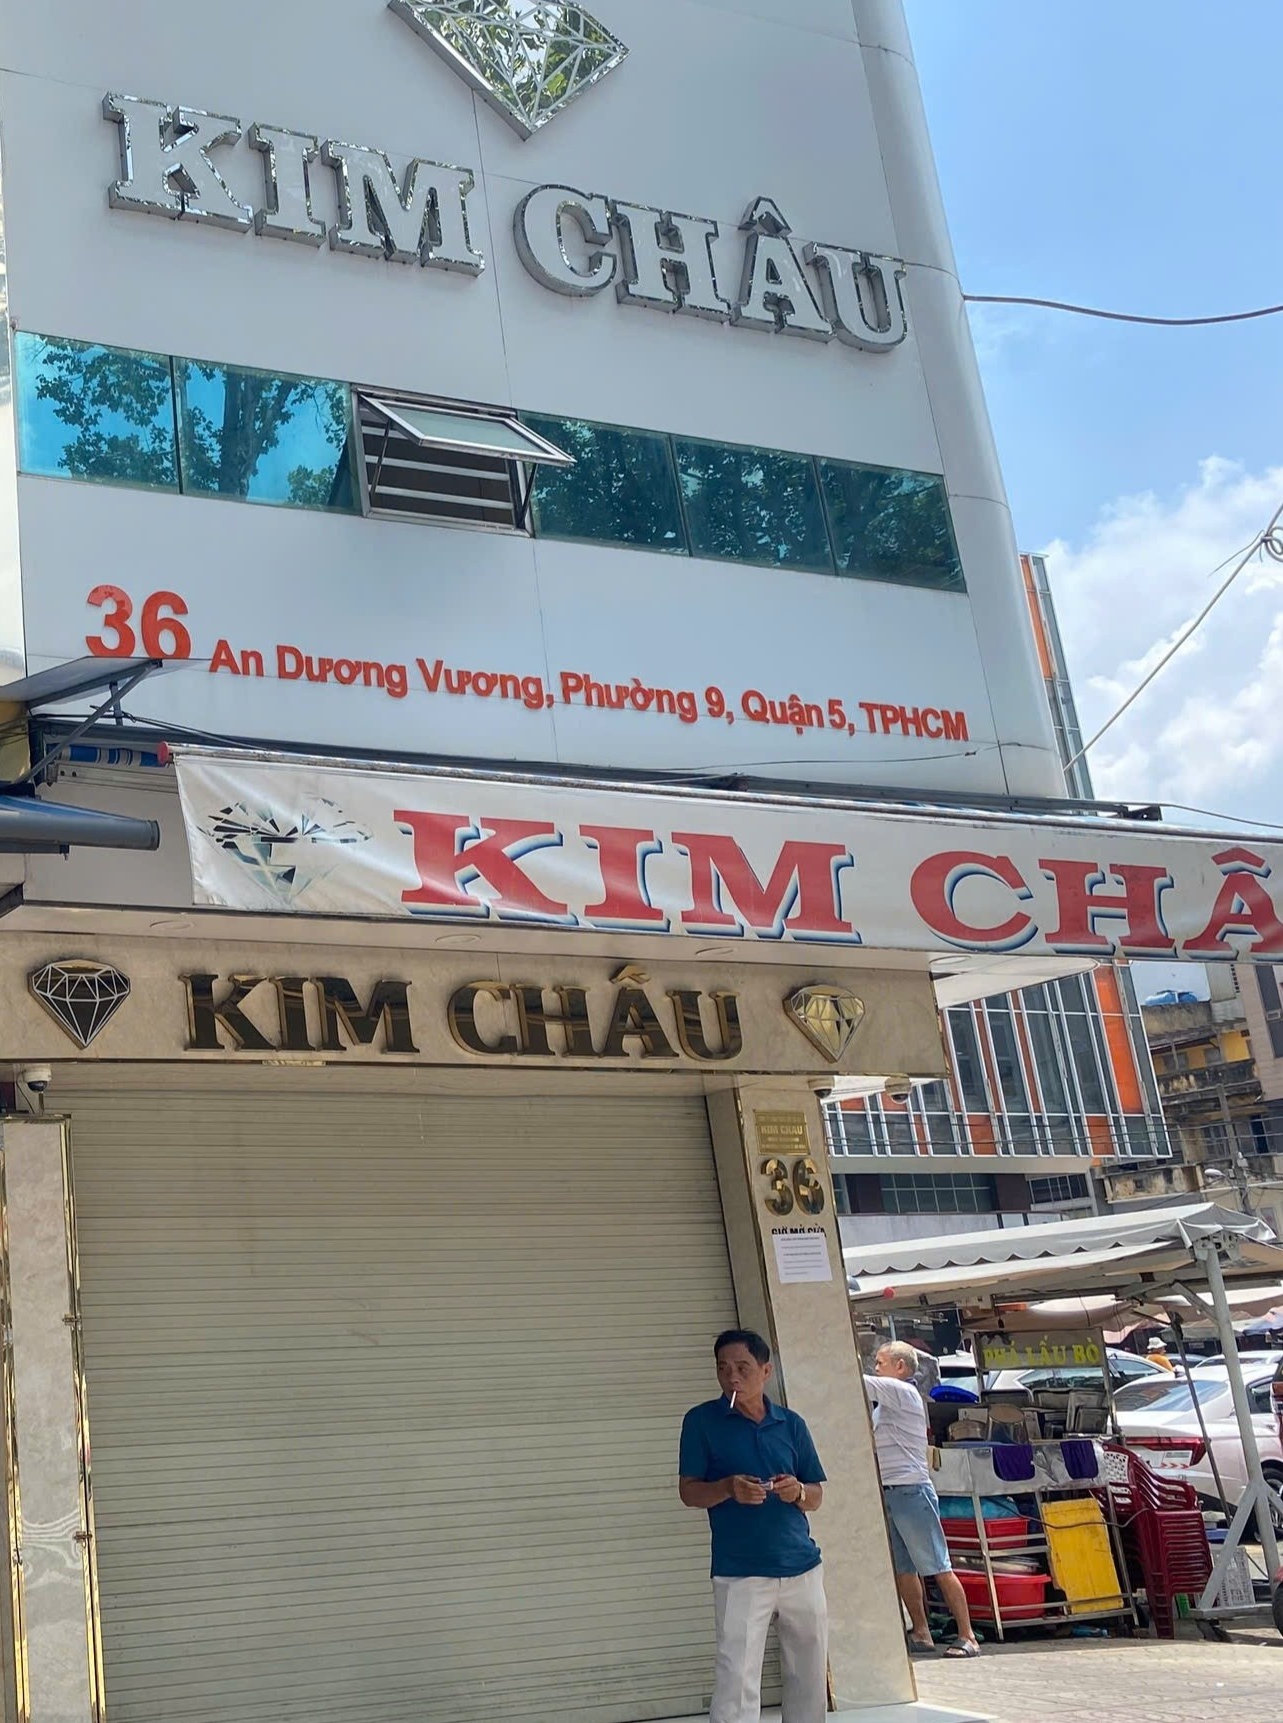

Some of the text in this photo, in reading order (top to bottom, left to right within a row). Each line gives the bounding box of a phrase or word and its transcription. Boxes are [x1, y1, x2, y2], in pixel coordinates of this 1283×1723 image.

[102, 91, 909, 353] KIM CHÂU
[85, 584, 969, 742] 36 An Dương Vương, Phường 9, Quận 5, TPHCM
[392, 808, 862, 944] KIM
[178, 965, 743, 1062] KIM CHÂU
[760, 1159, 825, 1216] 36
[1025, 1334, 1067, 1367] LẤU
[1072, 1337, 1100, 1365] BÒ
